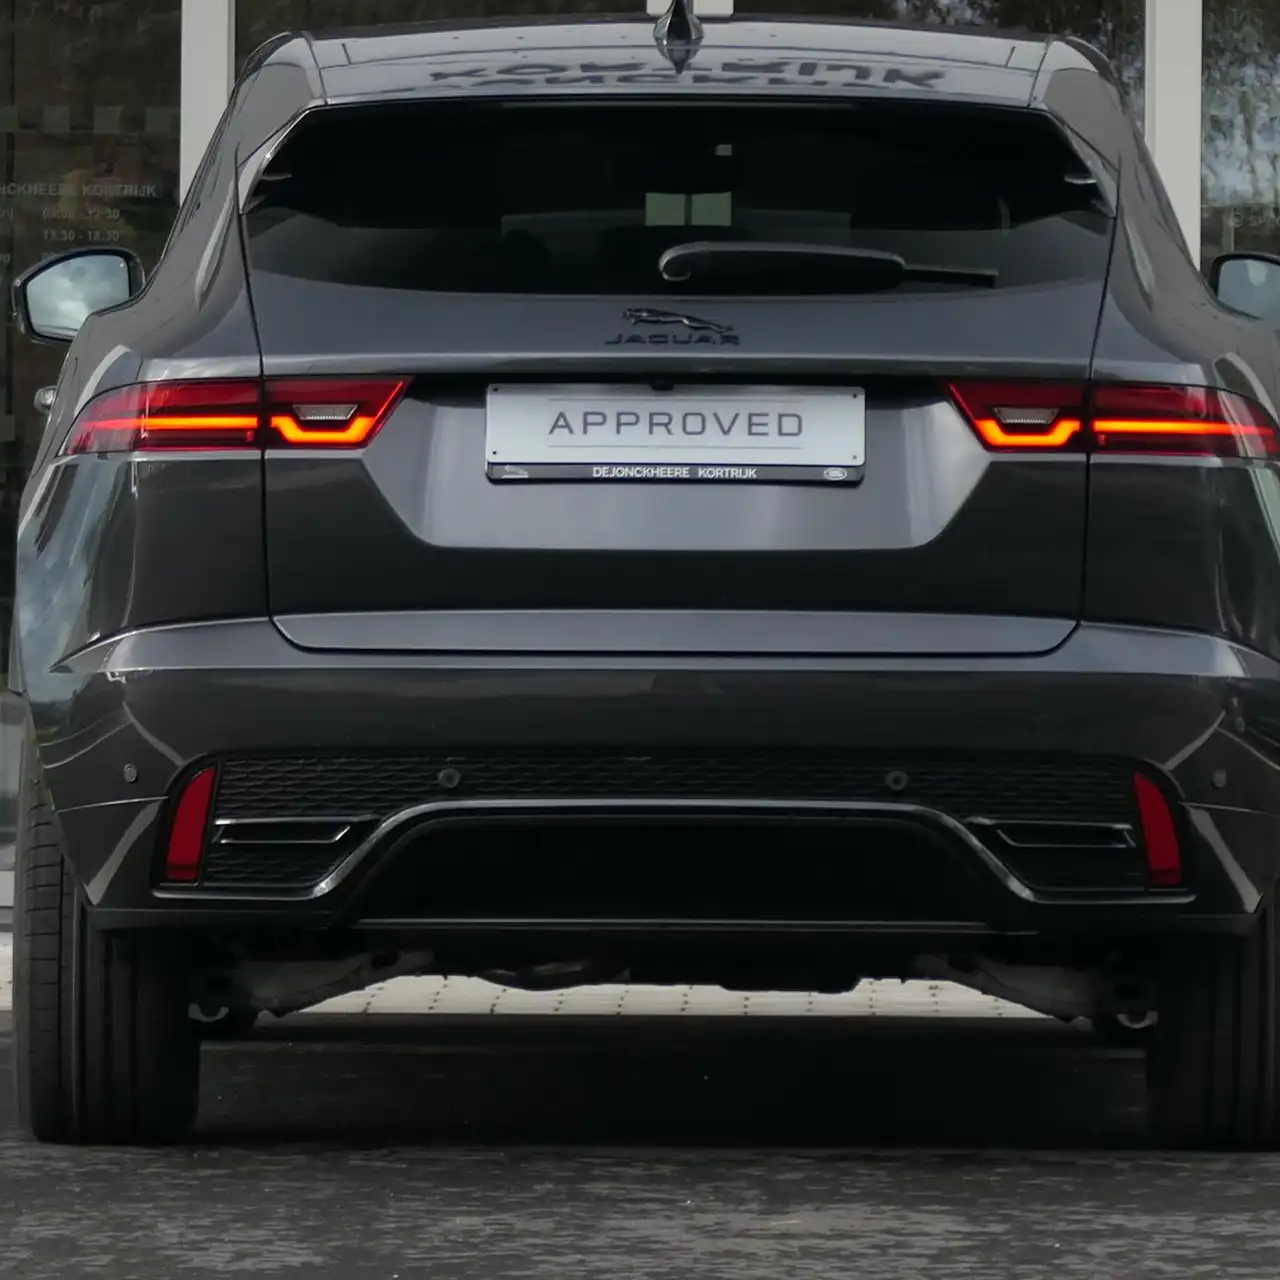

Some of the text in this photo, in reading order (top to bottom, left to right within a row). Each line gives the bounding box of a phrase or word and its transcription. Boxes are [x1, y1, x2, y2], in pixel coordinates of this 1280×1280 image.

[603, 333, 741, 346] JAGUAR
[549, 411, 802, 436] APPROVED
[592, 466, 758, 479] DEJONCKHEERE KORTRIJK
